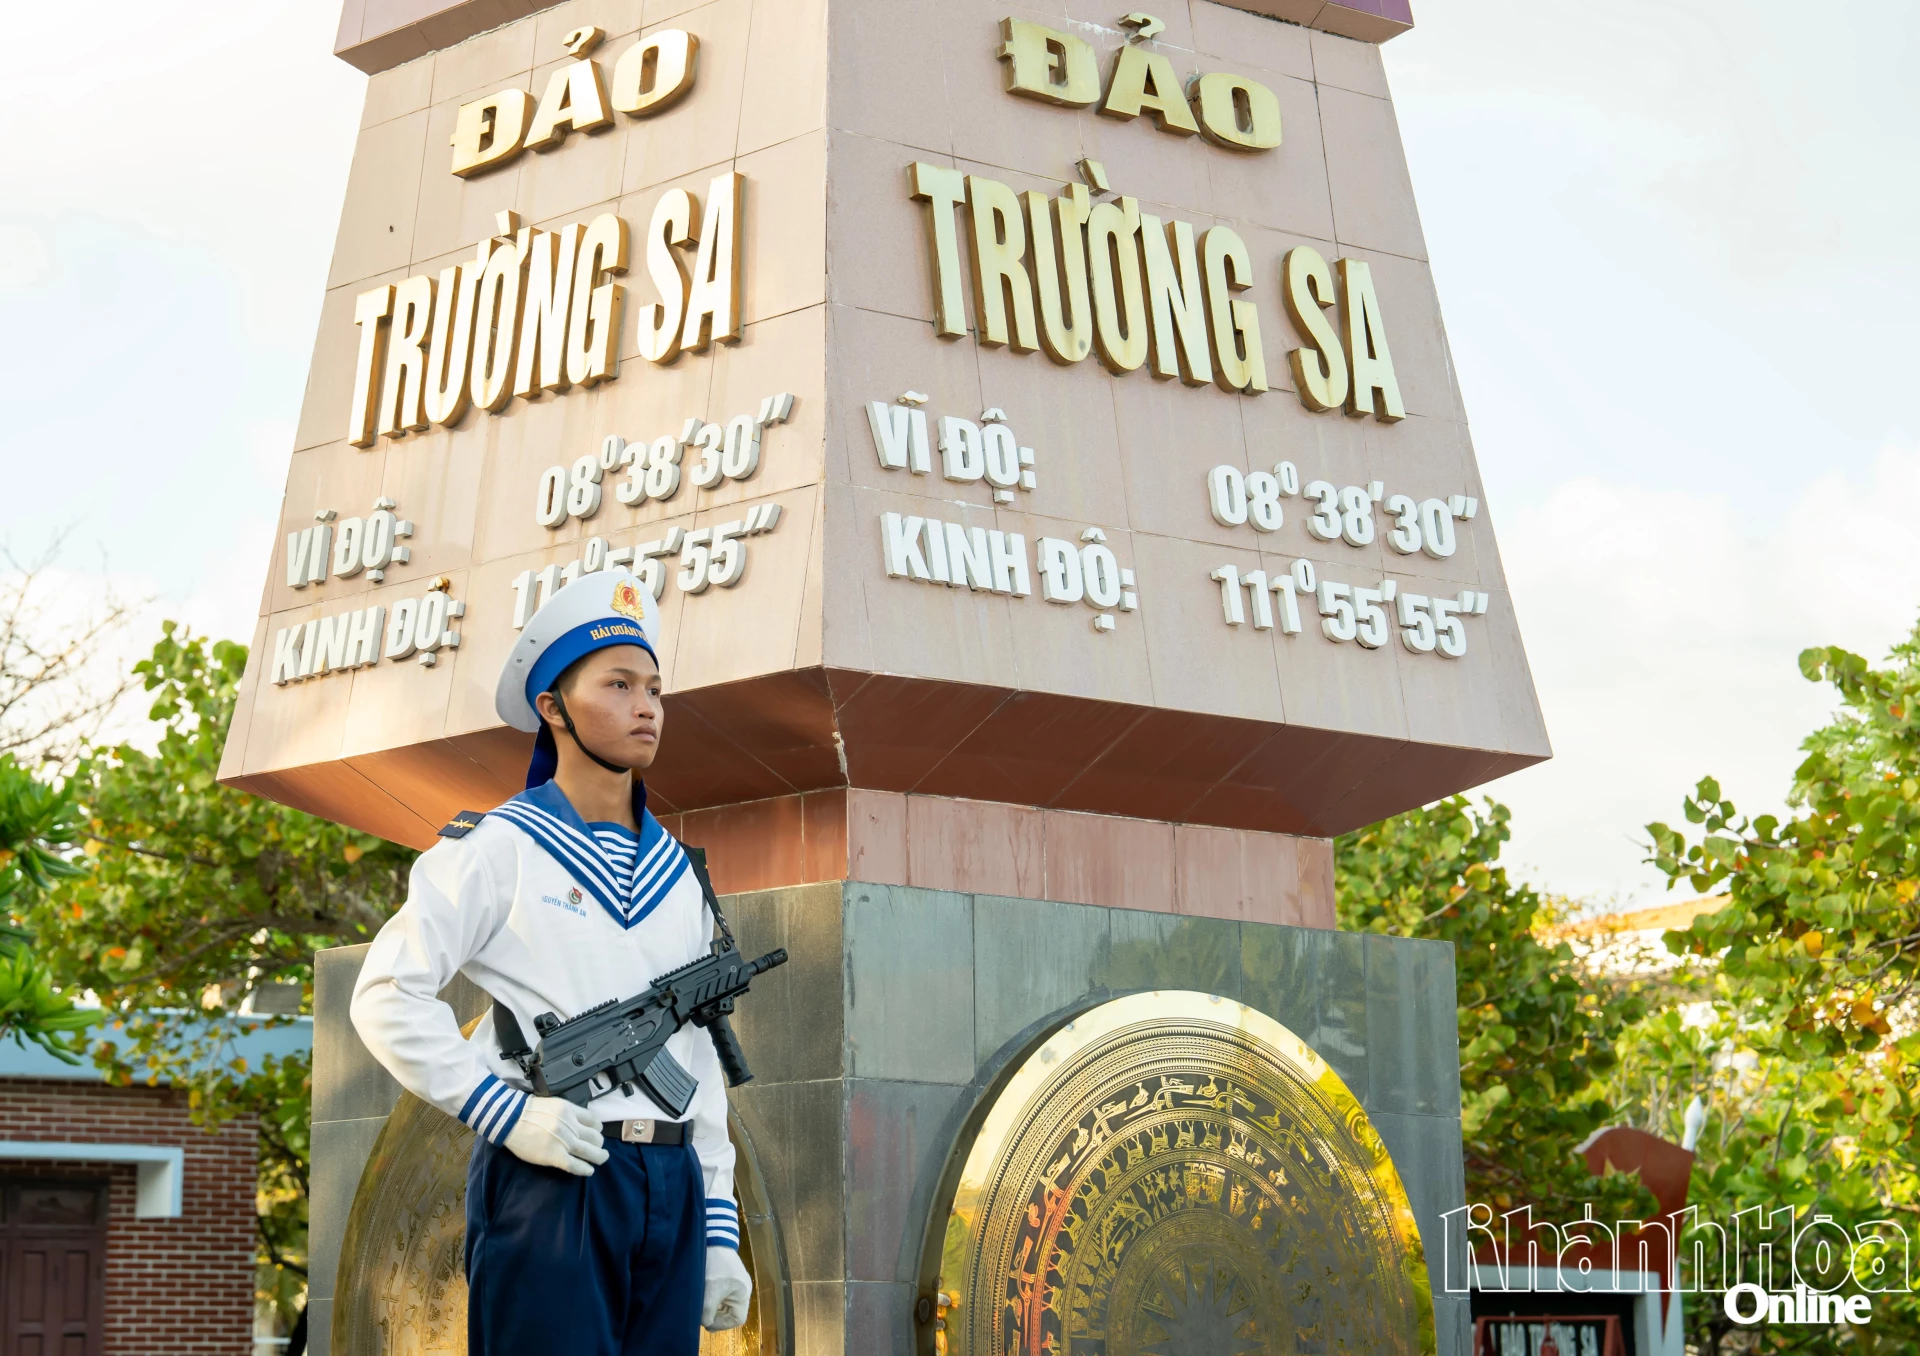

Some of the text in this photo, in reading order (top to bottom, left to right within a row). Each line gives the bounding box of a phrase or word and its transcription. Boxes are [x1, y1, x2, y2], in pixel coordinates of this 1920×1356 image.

[450, 25, 700, 178] ĐẢO
[996, 12, 1282, 154] ĐẢO
[348, 171, 745, 449] TRƯỜNG SA
[906, 157, 1406, 425] TRƯỜNG SA
[865, 390, 931, 476] VĨ
[937, 407, 1037, 504] ĐỘ:
[287, 509, 338, 589] VĨ
[332, 495, 413, 583] ĐỘ:
[880, 512, 1031, 598] KINH
[1036, 527, 1137, 632] ĐỘ:
[270, 605, 386, 686] KINH
[385, 575, 466, 667] ĐỘ:
[590, 624, 611, 641] HẢI
[610, 622, 639, 637] QUÂN
